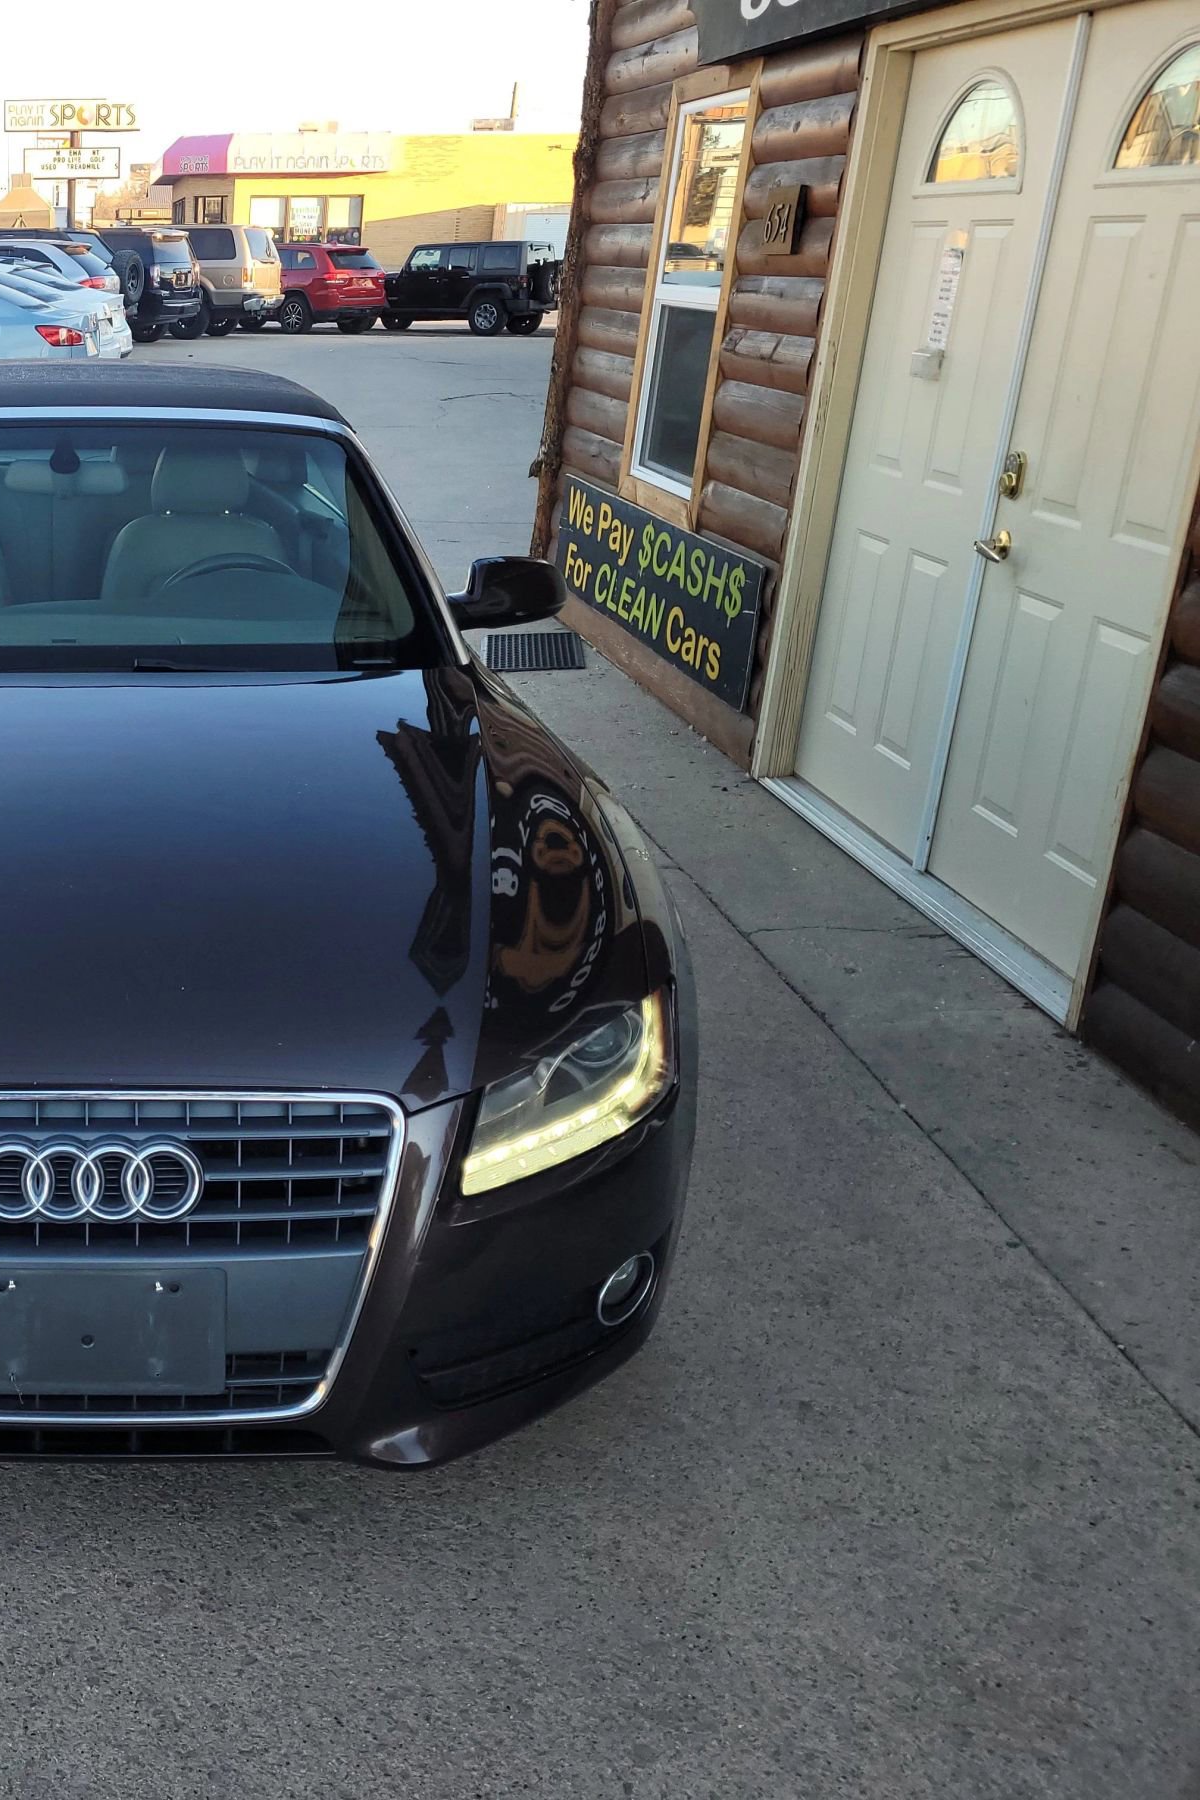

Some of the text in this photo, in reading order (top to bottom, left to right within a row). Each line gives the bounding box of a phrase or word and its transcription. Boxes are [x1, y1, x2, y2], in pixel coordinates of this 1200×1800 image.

[233, 156, 266, 169] PLAY
[270, 156, 282, 169] IT
[764, 203, 791, 243] 654
[568, 485, 746, 628] We Pay $CASH$
[564, 542, 721, 680] For CLEAN Cars
